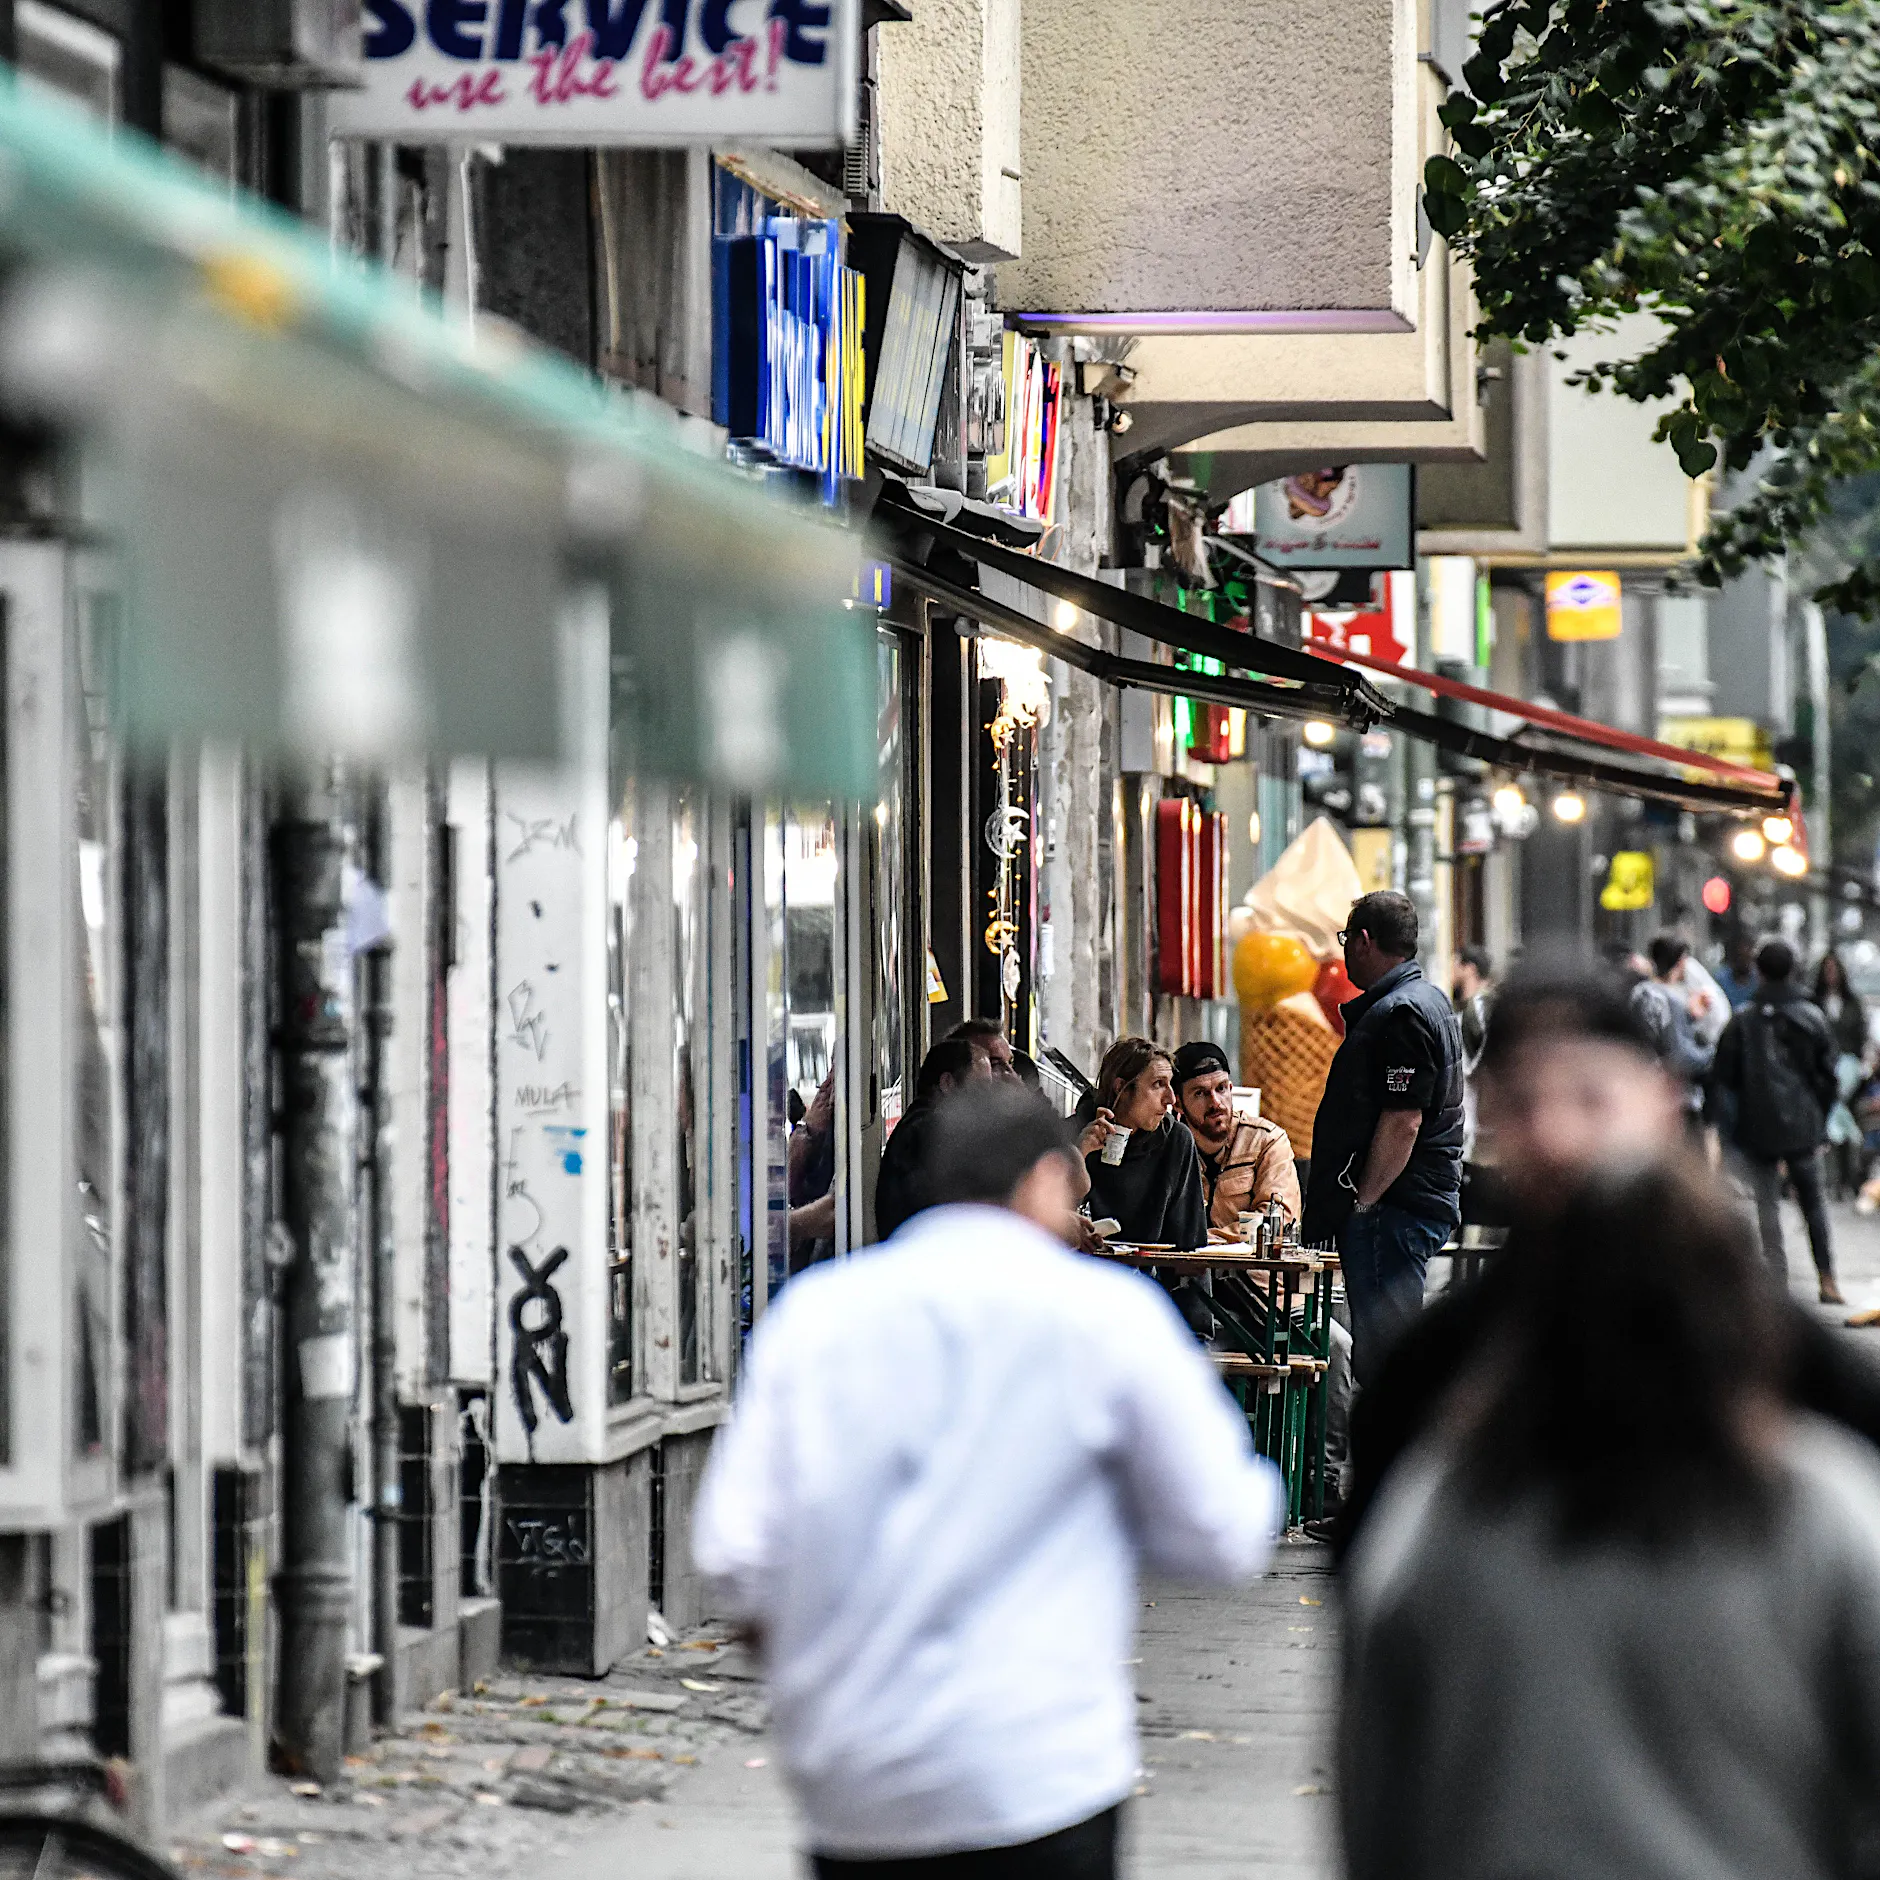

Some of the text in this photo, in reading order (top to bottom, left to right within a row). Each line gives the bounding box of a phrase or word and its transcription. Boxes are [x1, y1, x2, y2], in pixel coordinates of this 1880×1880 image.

[362, 0, 830, 65] SERVICE
[406, 19, 786, 111] use the best!
